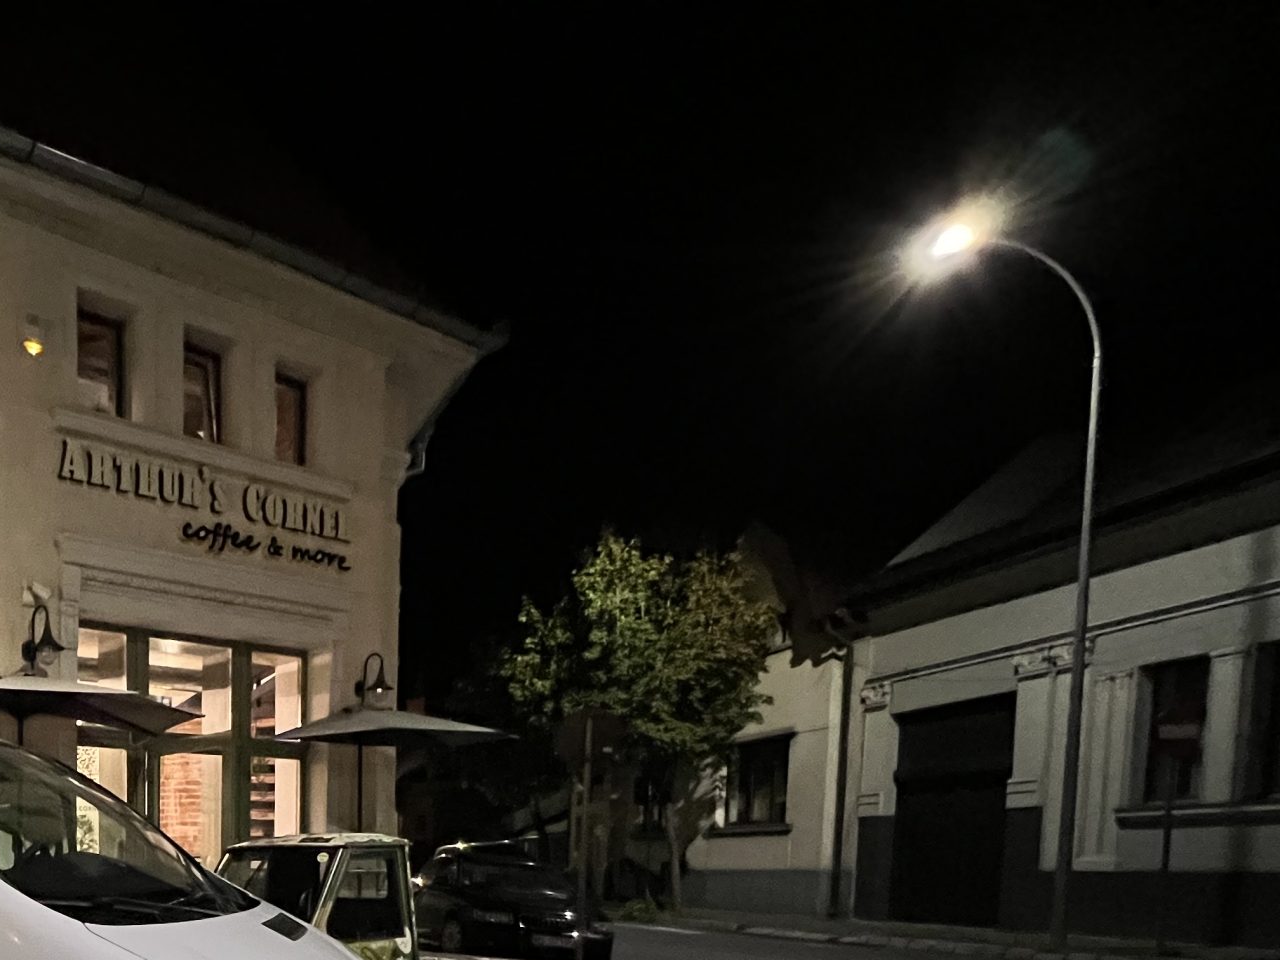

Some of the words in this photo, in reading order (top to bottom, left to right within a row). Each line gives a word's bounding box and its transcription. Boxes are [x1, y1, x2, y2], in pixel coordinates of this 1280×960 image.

[182, 521, 261, 552] coffee
[267, 536, 284, 557] &
[291, 545, 352, 572] more
